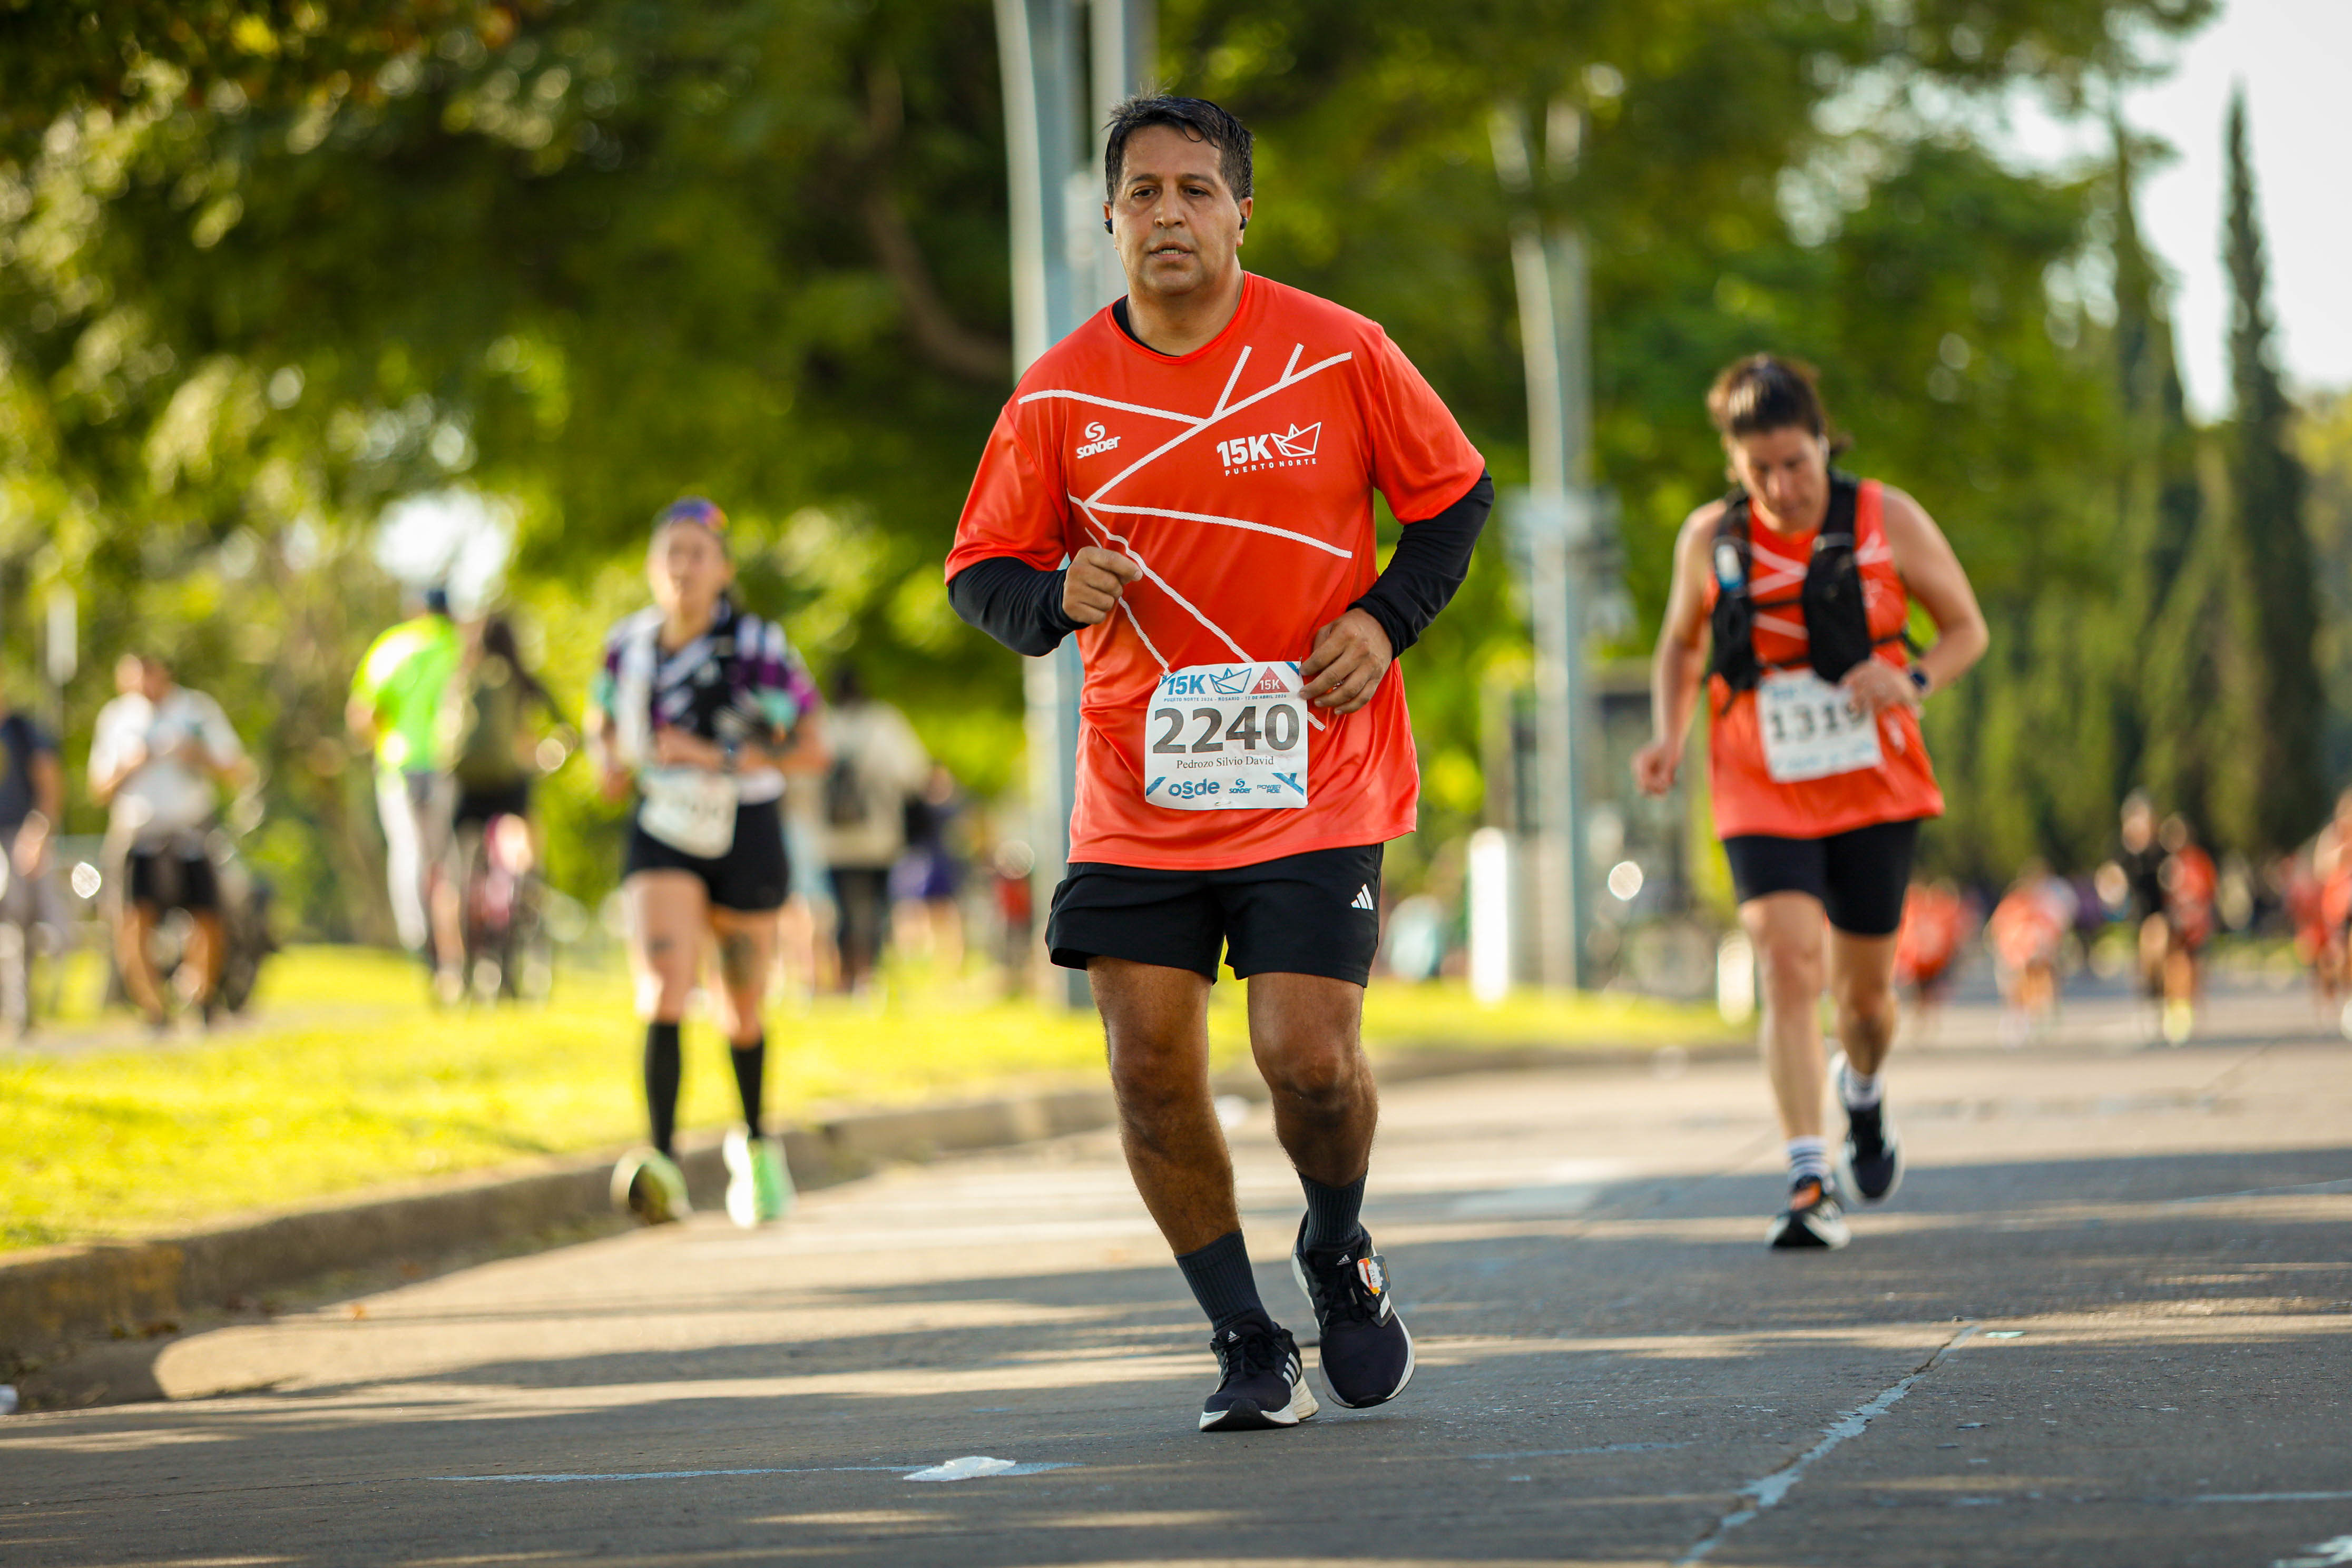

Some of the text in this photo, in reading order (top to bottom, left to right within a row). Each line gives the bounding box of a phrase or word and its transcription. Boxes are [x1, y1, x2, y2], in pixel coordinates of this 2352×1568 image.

[1216, 434, 1273, 467] 15K
[1225, 458, 1317, 476] PUERTO NORTE
[1167, 674, 1206, 695] 15K
[1259, 679, 1280, 690] 15K
[1153, 704, 1299, 754] 2240
[1176, 756, 1274, 769] Pedrozo Silvio David
[1168, 778, 1220, 797] osde
